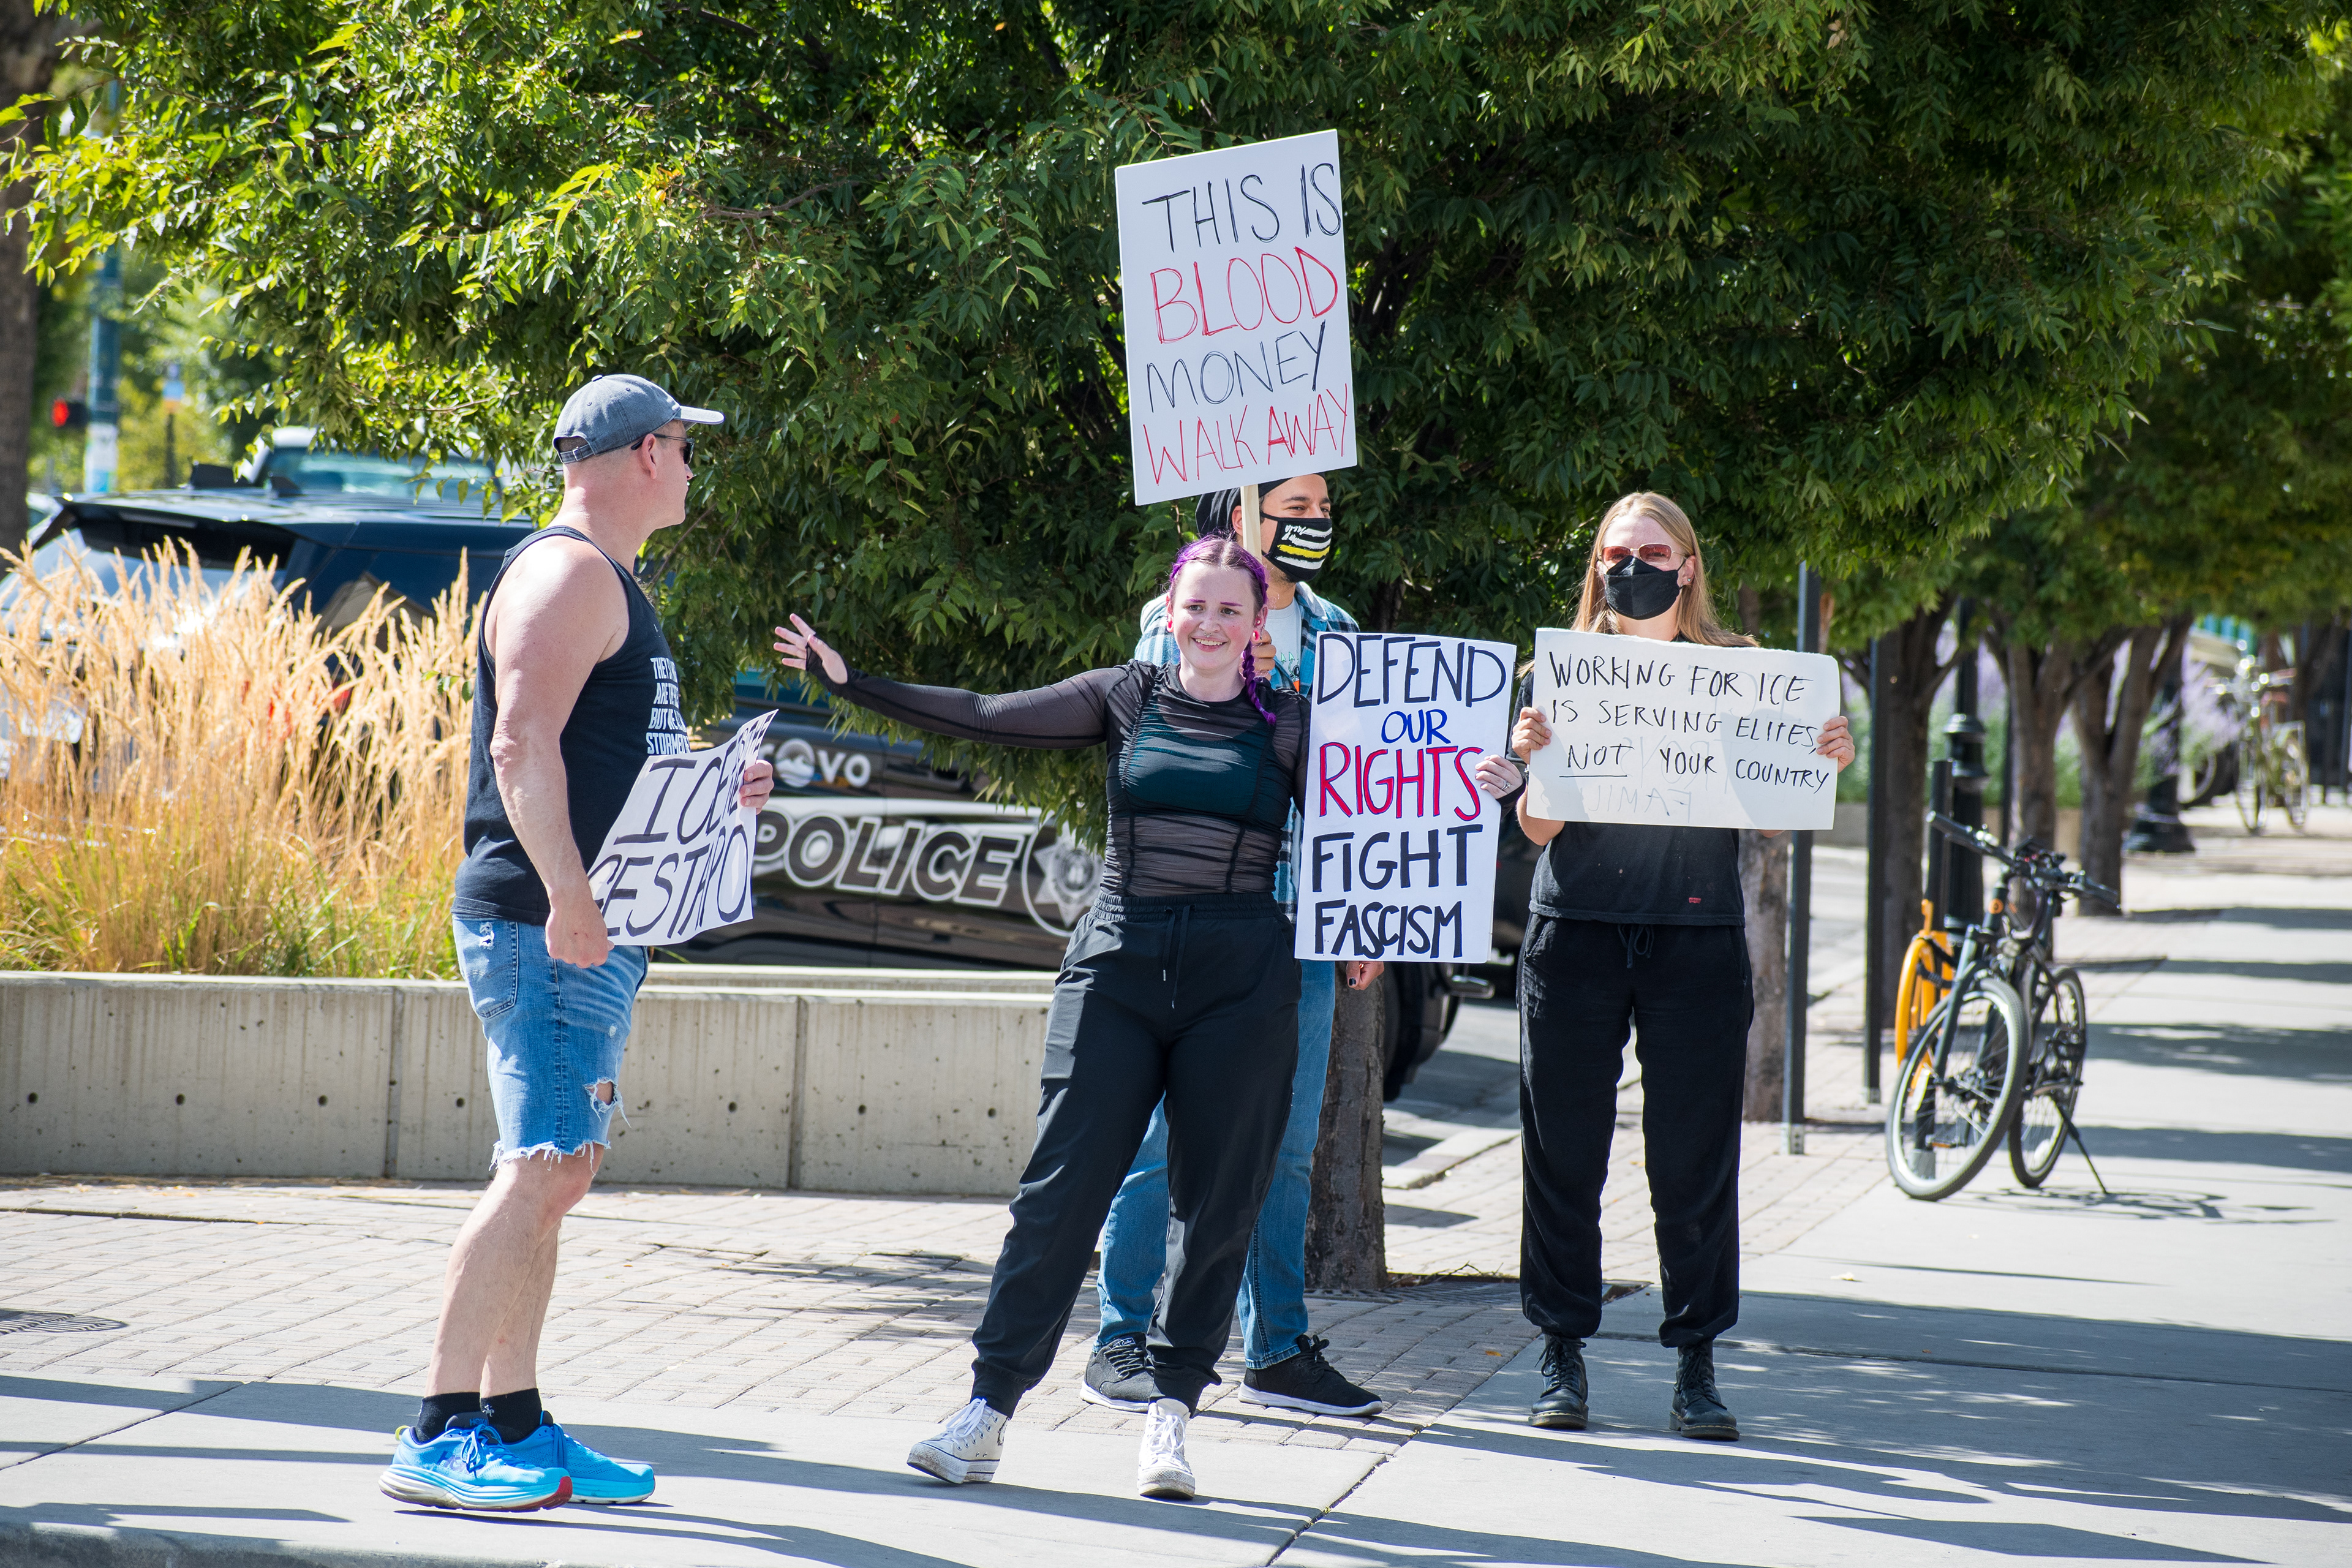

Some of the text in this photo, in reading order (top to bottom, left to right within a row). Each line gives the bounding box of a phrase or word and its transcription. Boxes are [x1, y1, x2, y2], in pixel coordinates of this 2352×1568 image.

[1142, 163, 1341, 252] THIS IS
[1150, 246, 1338, 344] BLOOD
[1147, 319, 1325, 413] MONEY
[1143, 383, 1348, 486] WALK AWAY
[653, 683, 668, 704] ARE
[1317, 633, 1506, 707] DEFEND
[1549, 651, 1813, 705] WORKING FOR ICE
[648, 708, 668, 729] BUT
[1382, 709, 1450, 744] OUR
[1553, 699, 1578, 723] IS
[1599, 699, 1722, 733] SERVING
[614, 740, 737, 845] ICE
[722, 760, 746, 820] NE
[1319, 742, 1483, 821] RIGHTS
[1568, 744, 1829, 794] NOT YOUR COUNTRY
[753, 805, 1026, 907] POLICE
[1312, 824, 1483, 892] FIGHT
[1314, 899, 1462, 959] FASCISM
